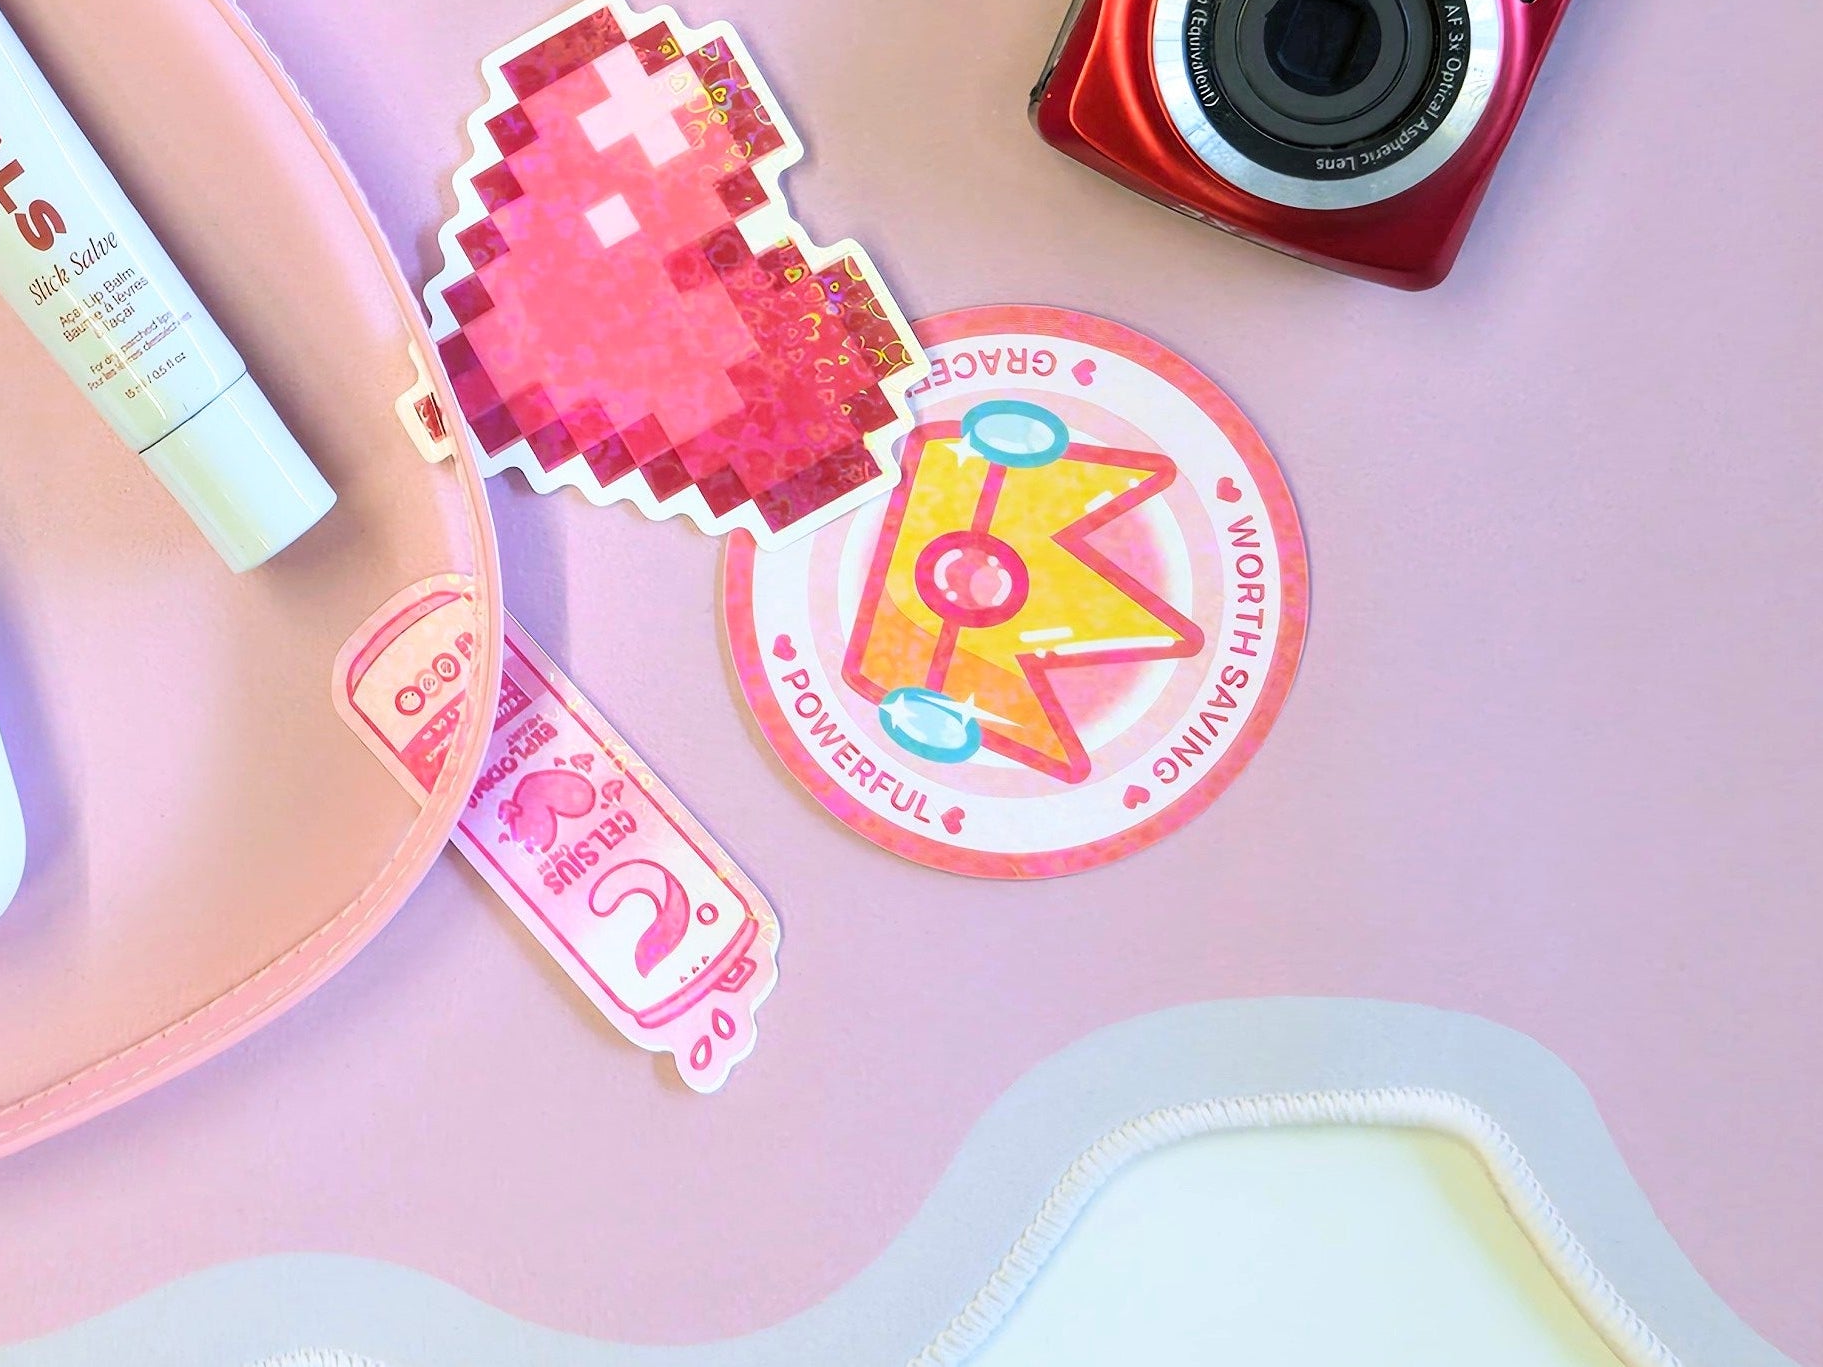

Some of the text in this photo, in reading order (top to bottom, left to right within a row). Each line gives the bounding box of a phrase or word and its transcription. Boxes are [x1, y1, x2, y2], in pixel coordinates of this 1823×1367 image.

[1444, 4, 1463, 27] AF
[1428, 58, 1462, 119] Optical
[1315, 156, 1357, 171] Lens
[1361, 117, 1430, 167] Aspheric
[28, 231, 119, 306] Slick Salve
[83, 288, 106, 311] Lip
[103, 266, 136, 293] Balm
[111, 274, 150, 305] lèvres
[908, 347, 1058, 399] GRACE
[1151, 513, 1266, 785] WORTH SAVING
[781, 669, 933, 825] POWERFUL
[541, 808, 639, 896] CELSIUS
